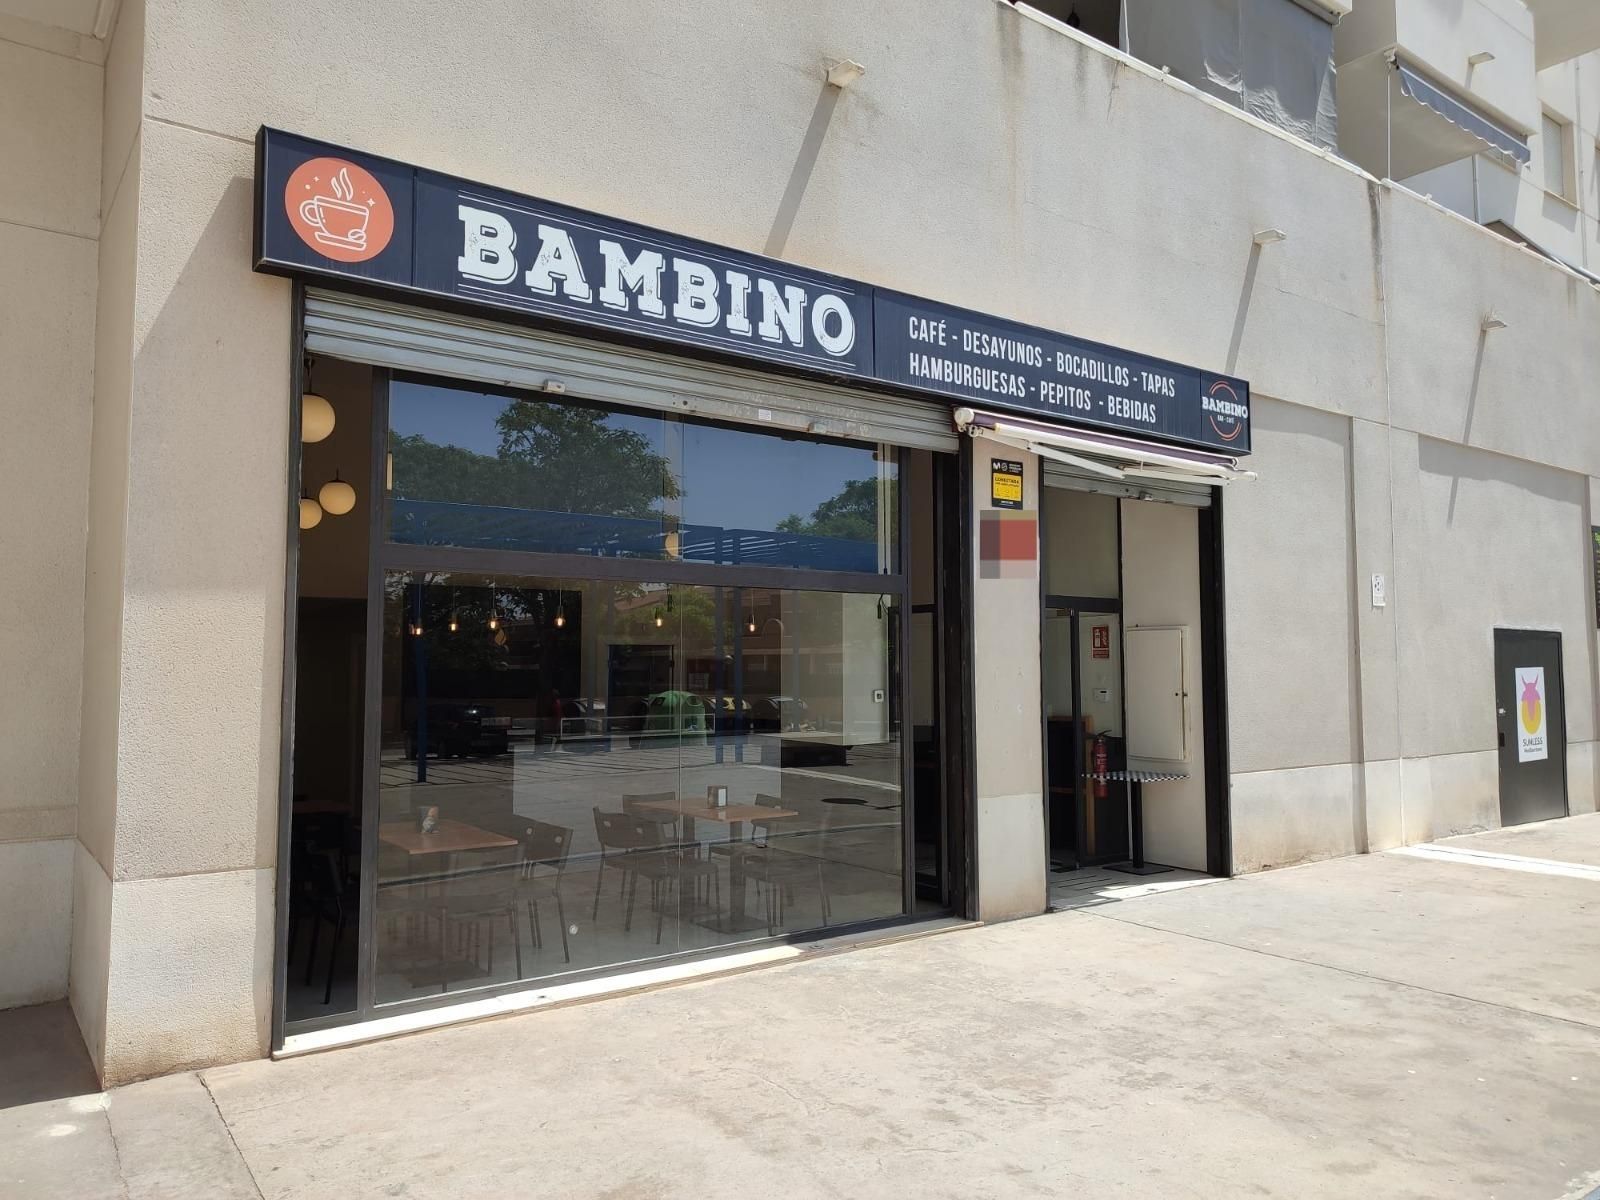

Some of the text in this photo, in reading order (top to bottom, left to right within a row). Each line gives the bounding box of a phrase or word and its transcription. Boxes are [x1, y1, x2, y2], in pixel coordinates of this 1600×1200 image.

[457, 204, 855, 356] BAMBINO
[909, 316, 947, 346] CAFÉ
[963, 329, 1042, 368] DESAYUNOS
[1057, 351, 1129, 387] BOCADILLOS
[1141, 371, 1176, 397] TAPAS
[909, 352, 1026, 398] HAMBURGUESAS
[1040, 380, 1092, 411] PEPITOS
[1107, 394, 1156, 424] BEBIDAS
[1202, 396, 1248, 418] BAMBINO
